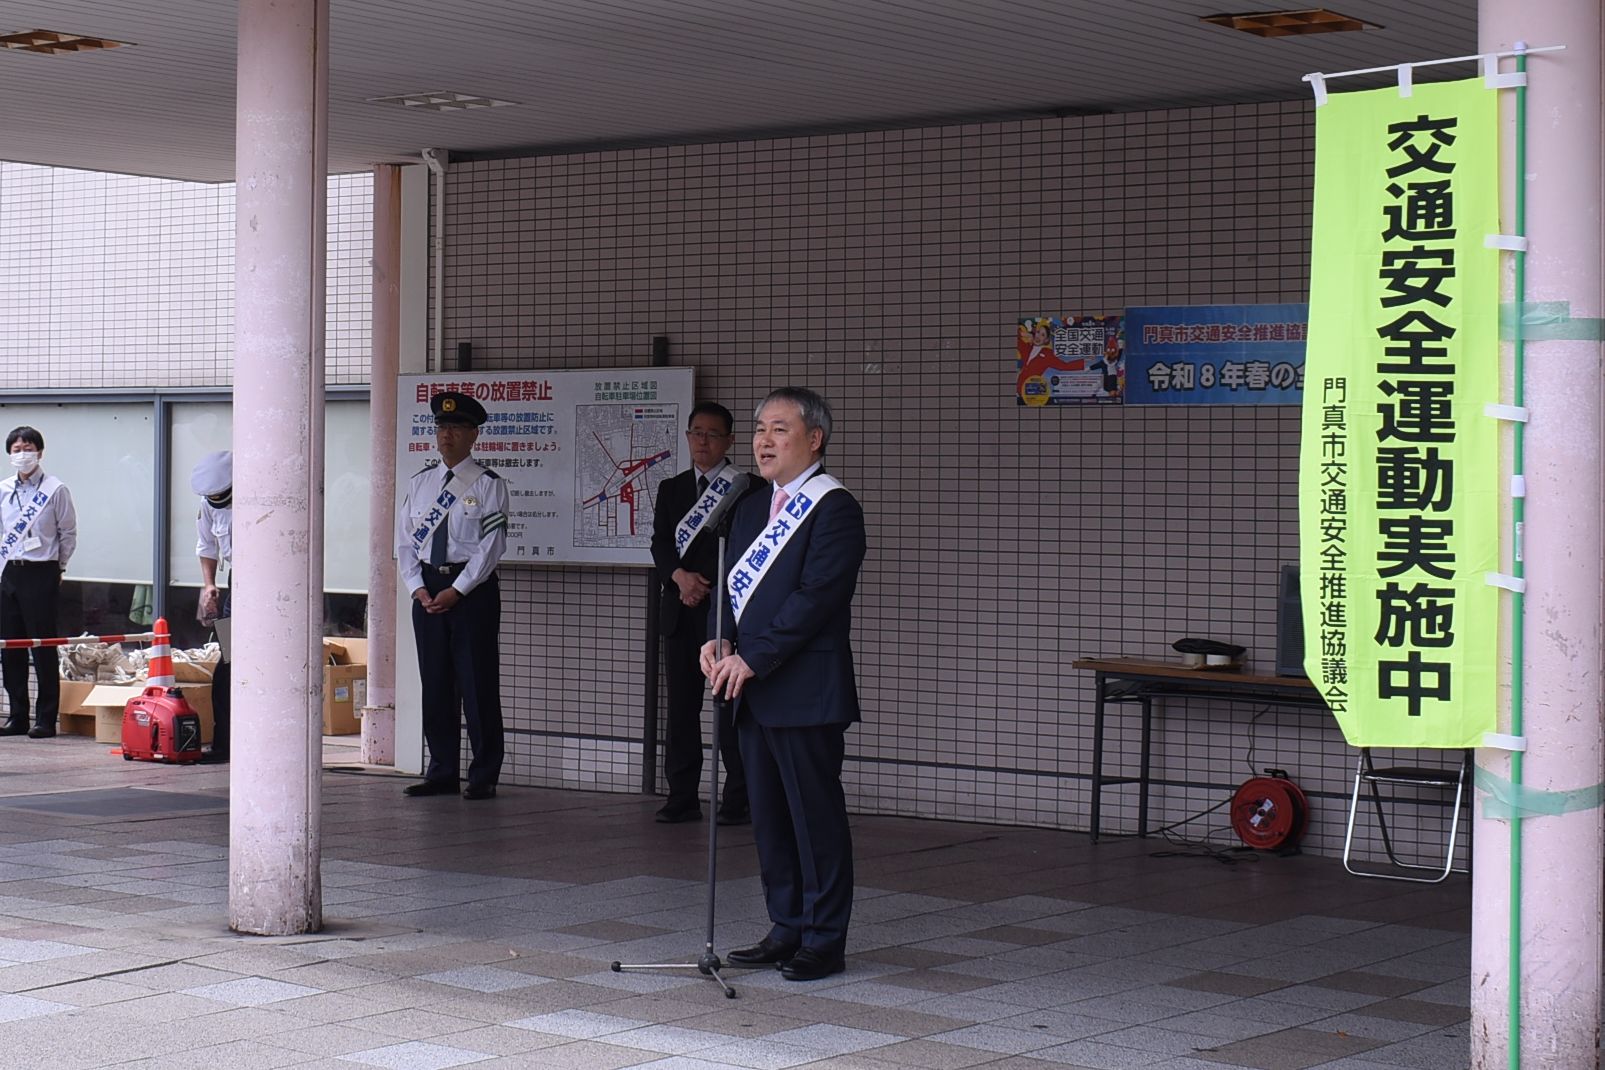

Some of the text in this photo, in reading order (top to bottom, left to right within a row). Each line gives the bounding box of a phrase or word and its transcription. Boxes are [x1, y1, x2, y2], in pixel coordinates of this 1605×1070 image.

[1055, 328, 1105, 342] 全国交通
[1055, 343, 1105, 356] 安全運動
[1375, 115, 1458, 716] 交通安全運動実施中
[675, 494, 718, 554] 交通安
[1319, 377, 1348, 713] 門真市交通安全推進協議会
